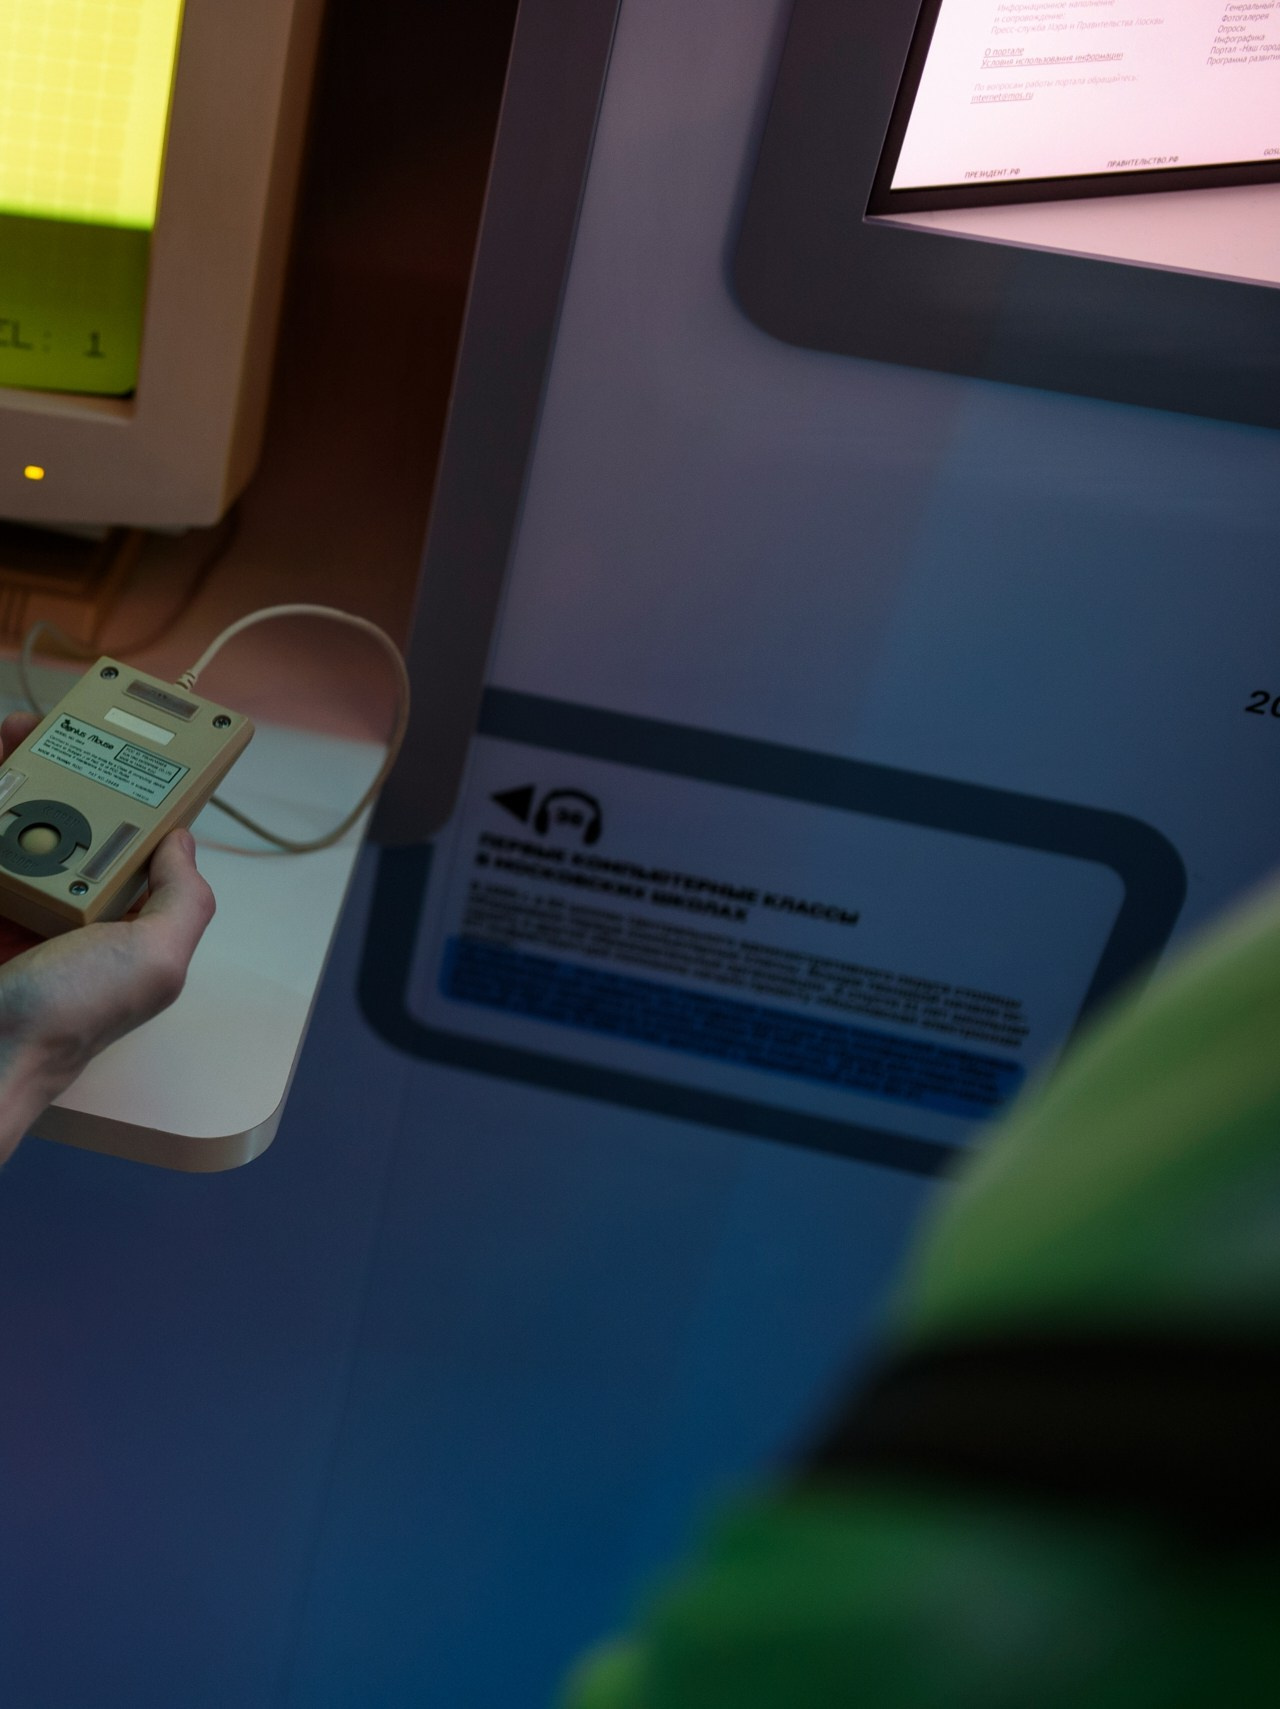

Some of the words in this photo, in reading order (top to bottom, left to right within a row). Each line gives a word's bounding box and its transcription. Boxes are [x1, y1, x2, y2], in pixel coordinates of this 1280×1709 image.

[1218, 25, 1246, 34] Опросы
[87, 733, 115, 750] Mouse
[494, 857, 646, 900] МОСКОВСКИХ
[651, 891, 748, 923] ШКОЛАХ
[571, 854, 759, 904] КОМПЬЮТЕРНЫЕ
[762, 891, 860, 926] КЛАССЫ
